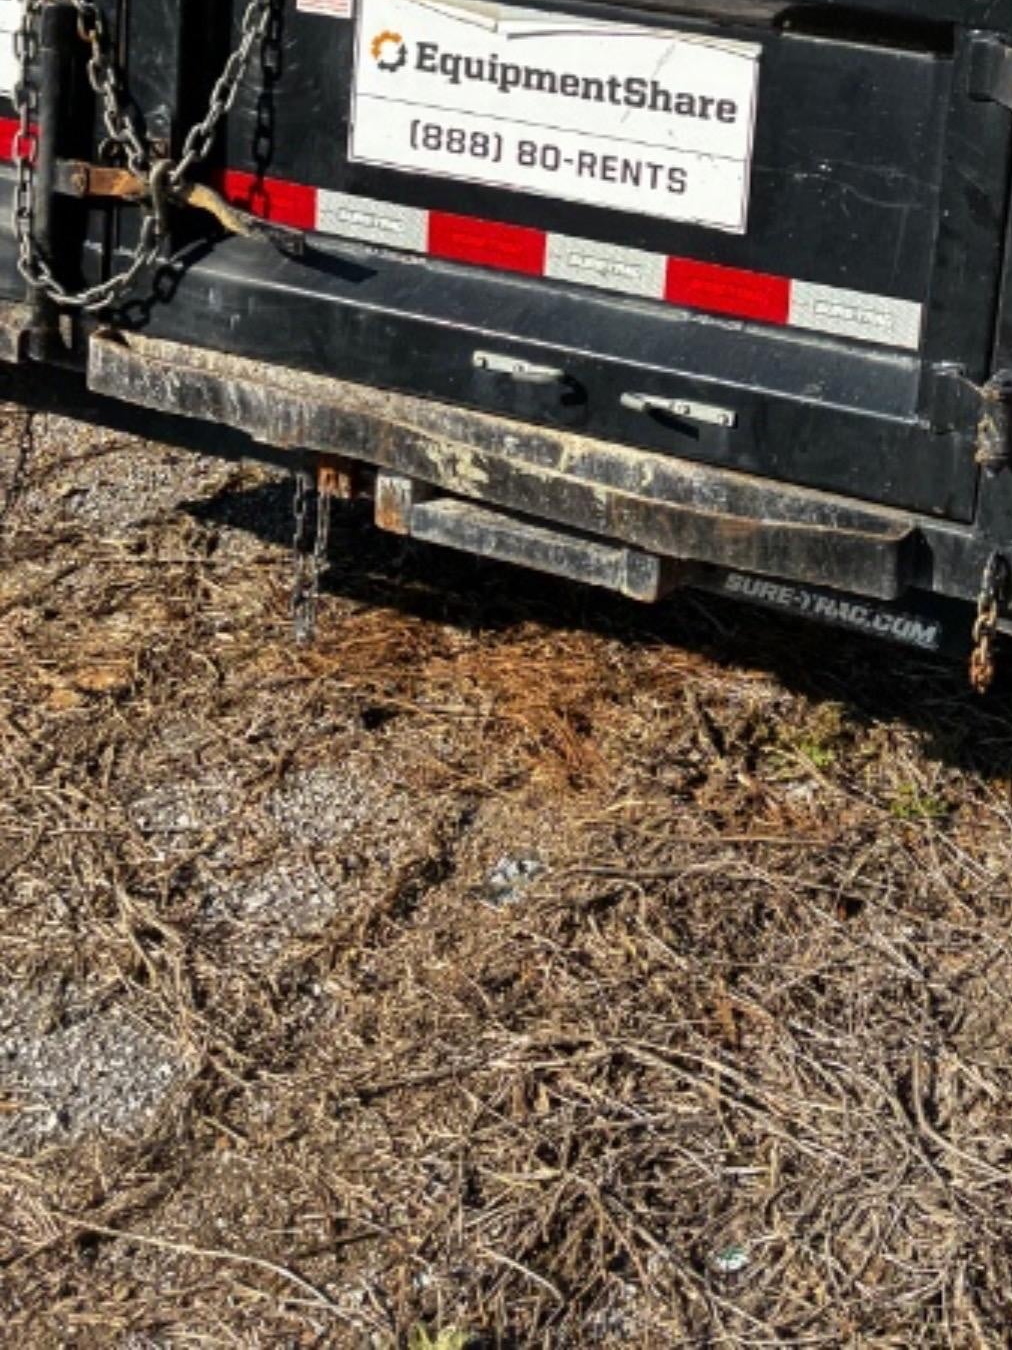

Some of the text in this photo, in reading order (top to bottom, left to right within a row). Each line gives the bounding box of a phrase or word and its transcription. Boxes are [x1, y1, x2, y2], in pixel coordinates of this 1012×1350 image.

[414, 41, 738, 124] EquipmentShare
[410, 119, 688, 195] (888) 80-RENTS
